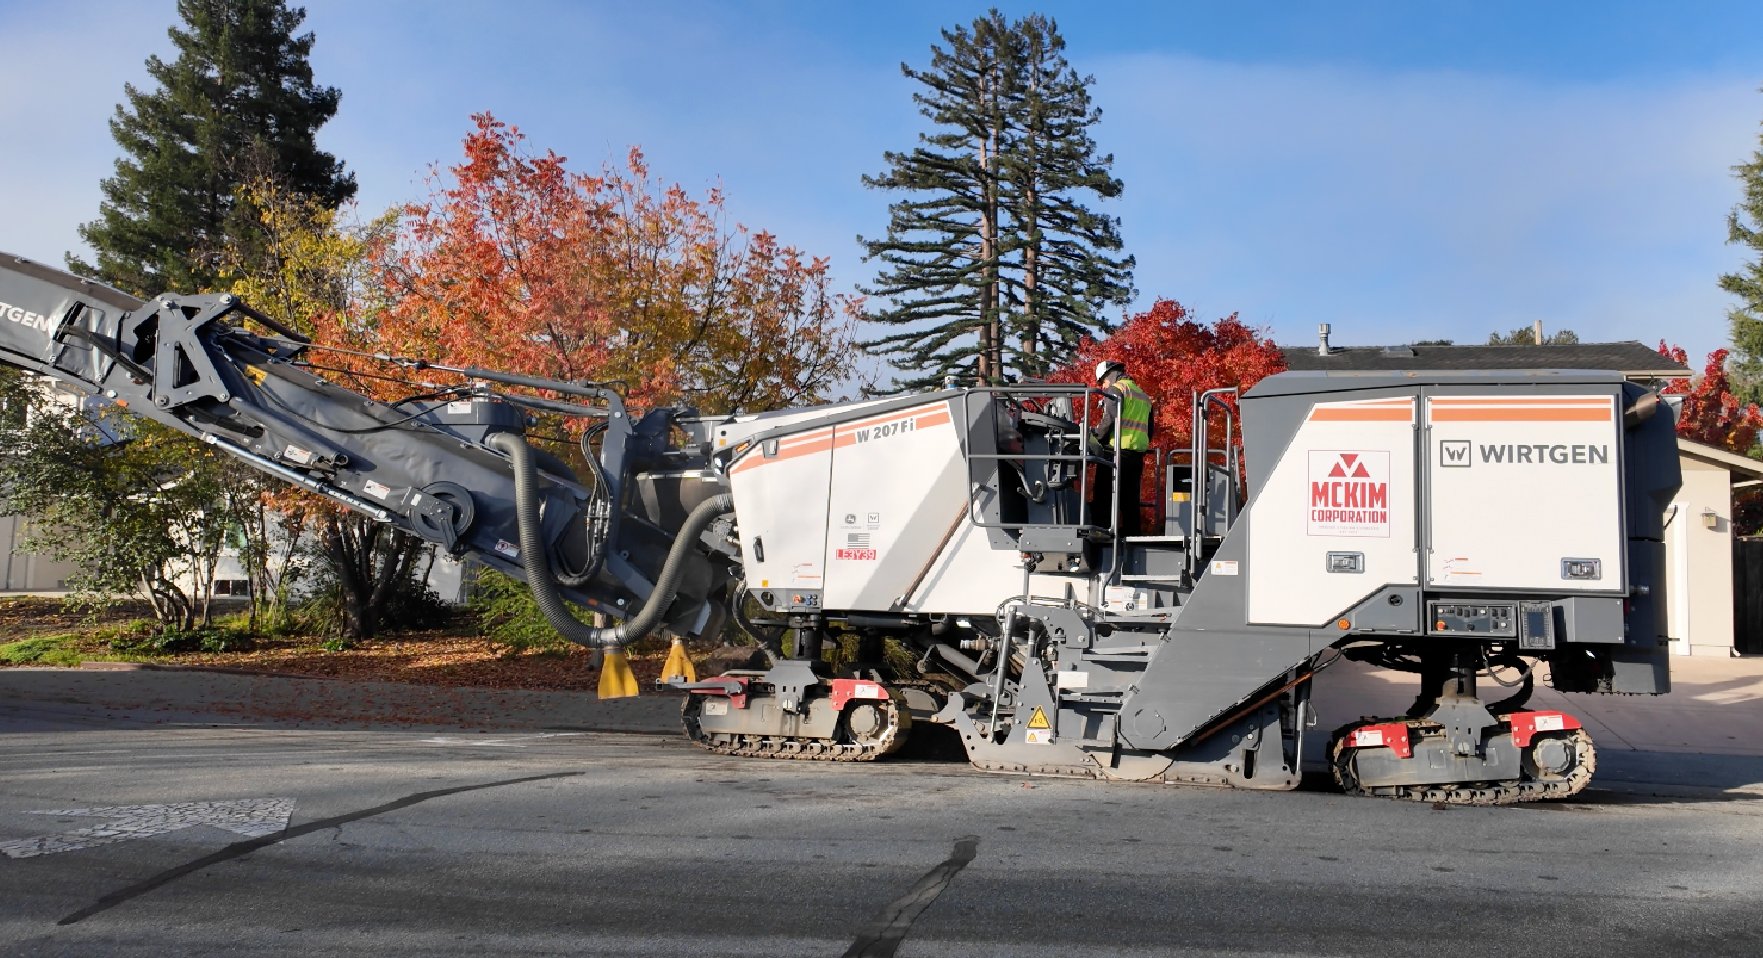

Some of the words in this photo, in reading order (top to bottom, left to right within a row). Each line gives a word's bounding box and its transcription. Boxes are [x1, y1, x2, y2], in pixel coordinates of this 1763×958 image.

[856, 429, 870, 444] W
[1479, 444, 1608, 464] WIRTGEN
[1312, 481, 1387, 509] MCKIM
[1311, 509, 1388, 524] CORPORATION
